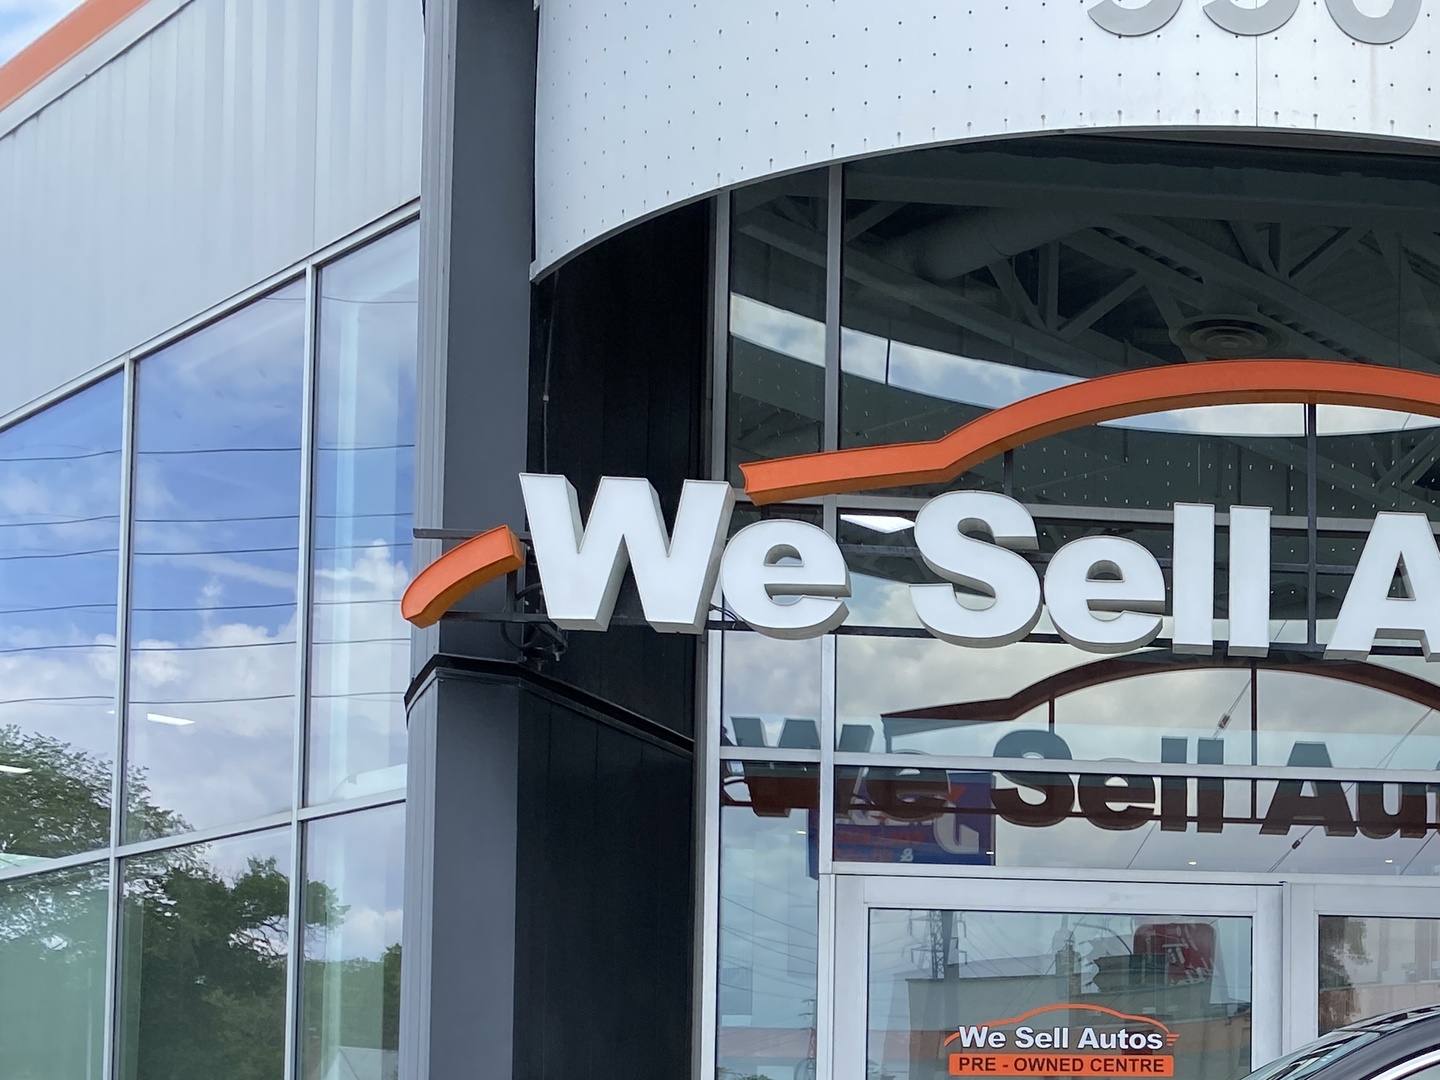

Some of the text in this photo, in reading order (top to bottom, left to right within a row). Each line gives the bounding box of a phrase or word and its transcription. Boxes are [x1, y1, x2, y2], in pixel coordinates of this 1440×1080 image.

[518, 471, 852, 640] We
[909, 488, 1273, 658] Sell
[957, 1025, 1164, 1050] We Sell Autos
[958, 1057, 996, 1072] PRE
[1013, 1057, 1084, 1073] OWNED
[1089, 1057, 1165, 1073] CENTRE
